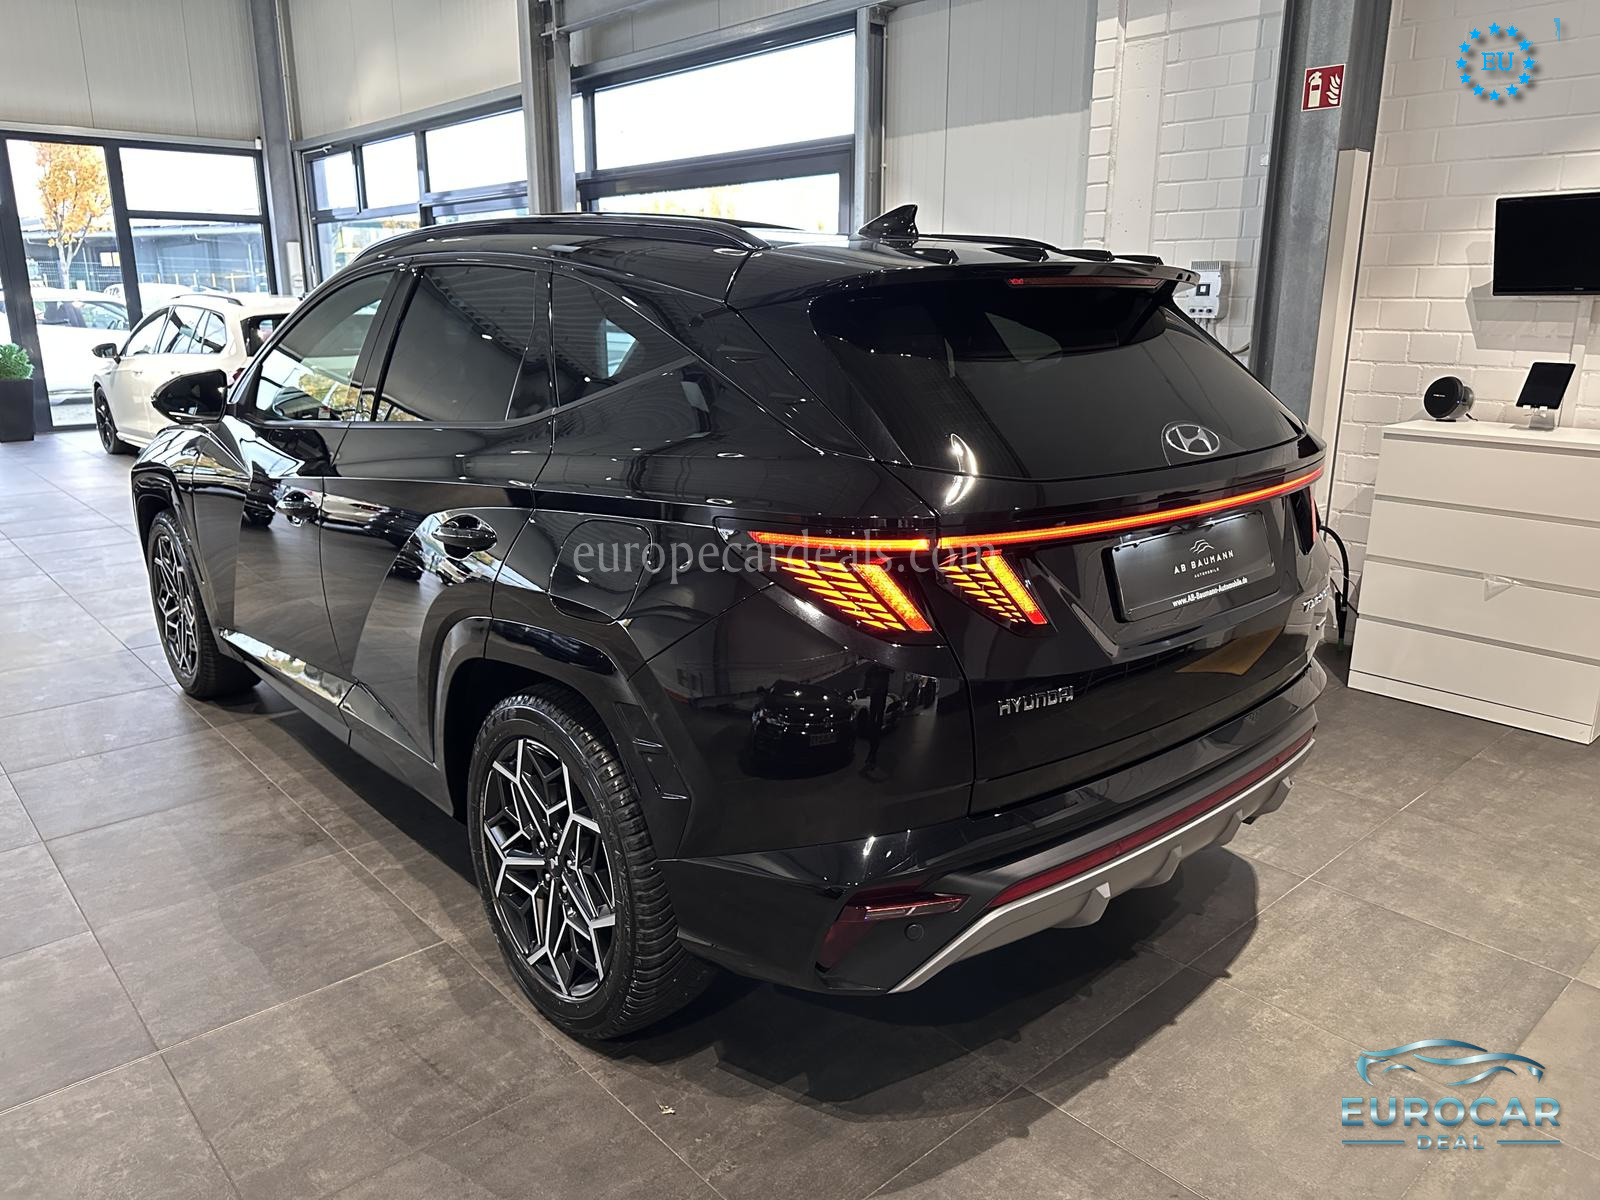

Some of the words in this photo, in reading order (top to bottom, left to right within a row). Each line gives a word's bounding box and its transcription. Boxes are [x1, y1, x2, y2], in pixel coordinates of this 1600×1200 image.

[1174, 563, 1187, 575] AB
[1190, 549, 1235, 570] BAUMANN
[997, 685, 1074, 717] HYUNDAI
